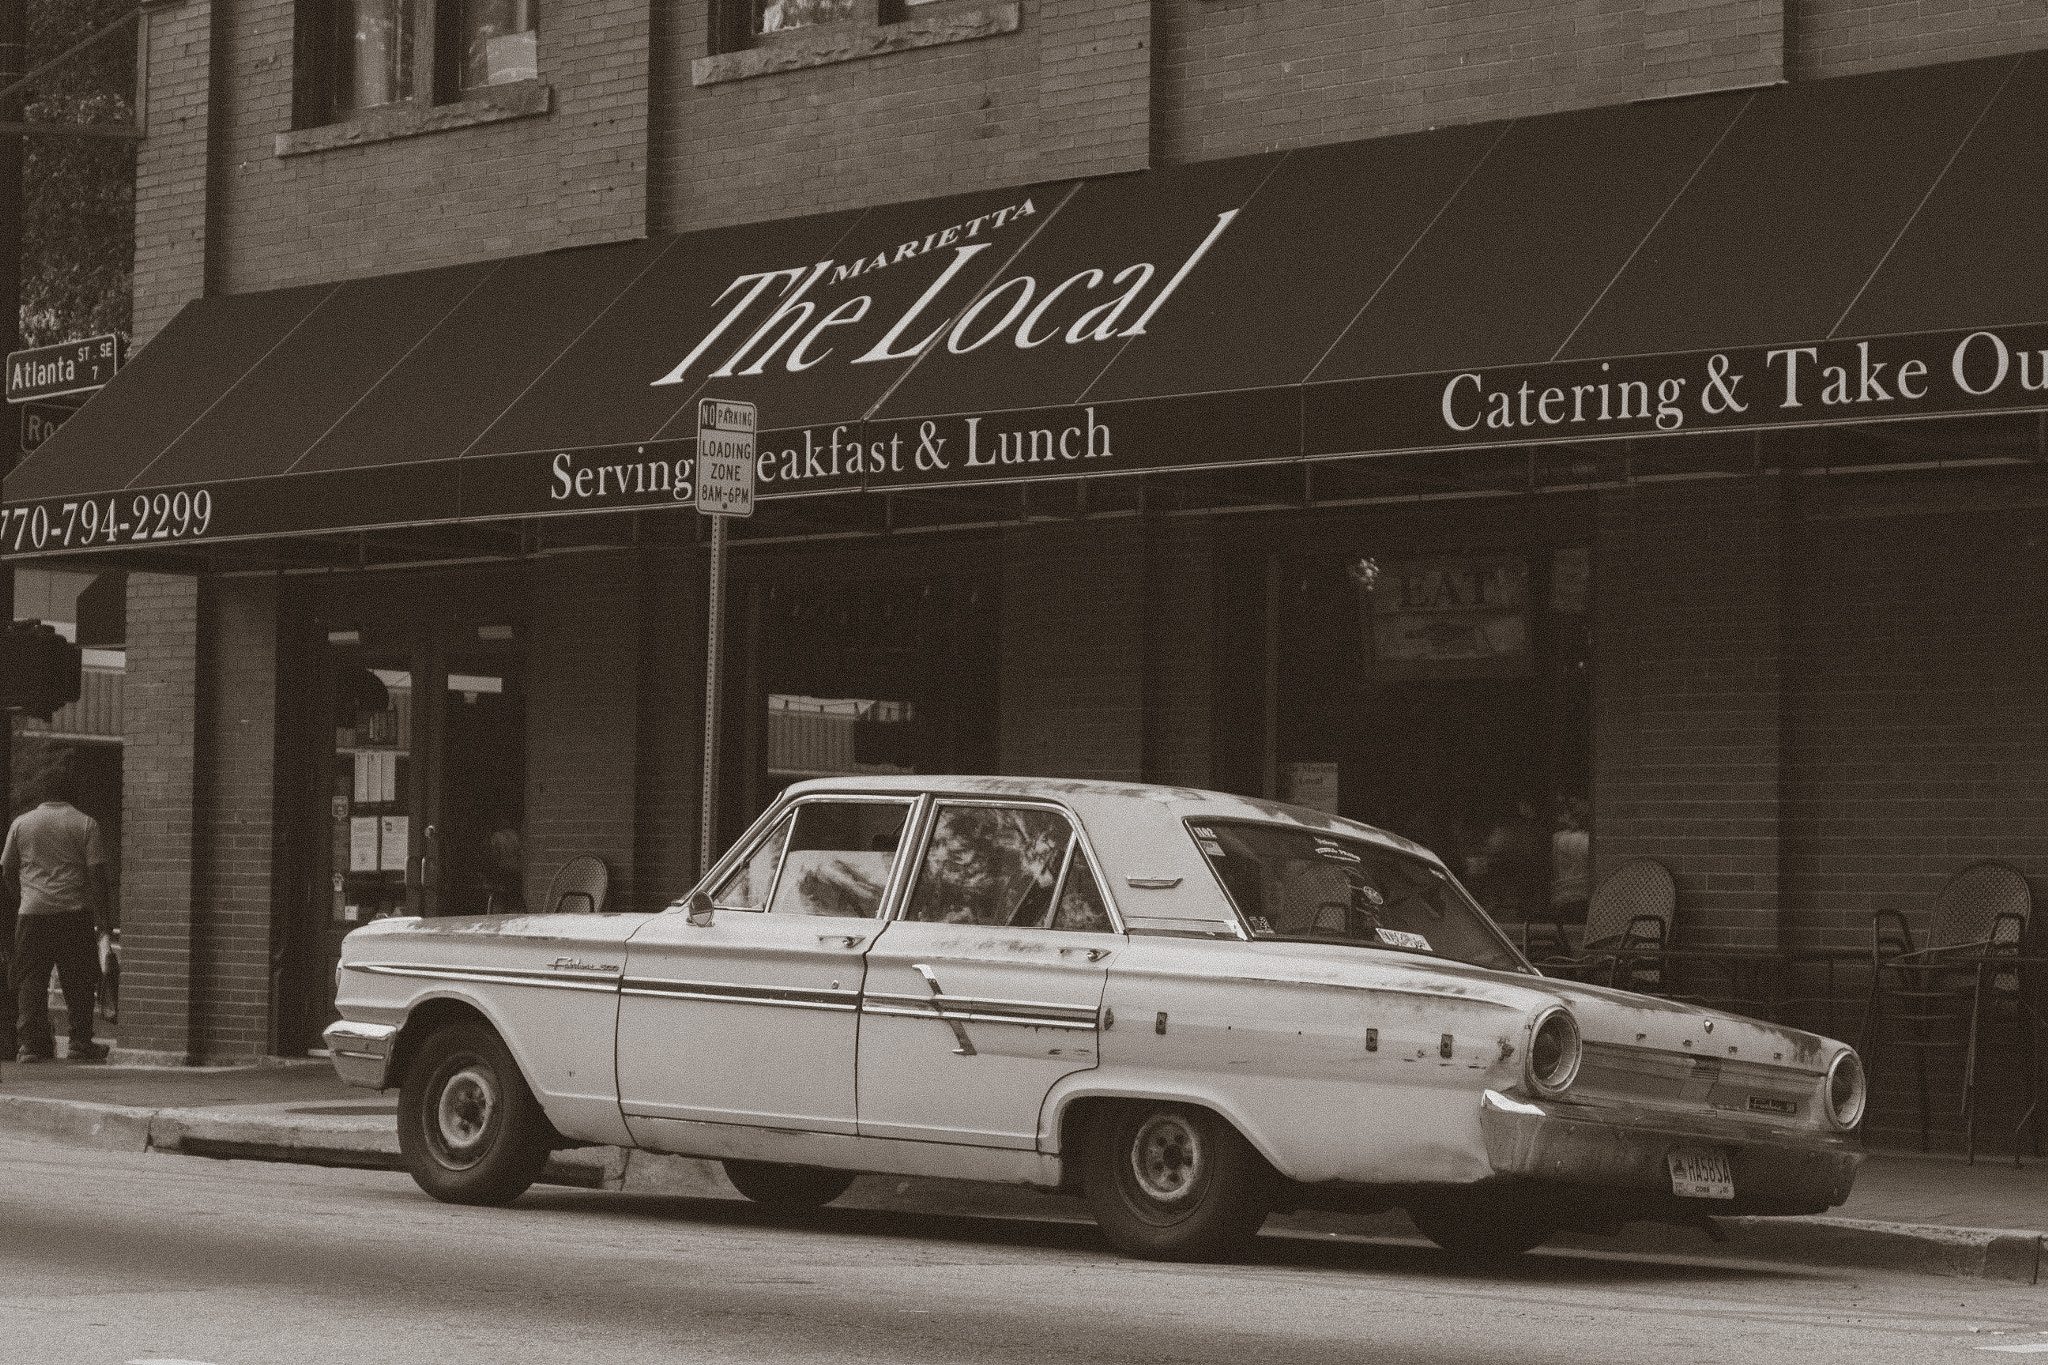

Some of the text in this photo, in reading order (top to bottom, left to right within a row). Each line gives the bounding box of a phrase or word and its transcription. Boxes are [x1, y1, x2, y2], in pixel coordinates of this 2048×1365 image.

[829, 198, 1036, 285] MARIETTA
[649, 207, 1241, 387] The Local
[11, 356, 75, 391] Atlanta
[99, 342, 113, 358] SE
[91, 365, 99, 380] 7
[1441, 362, 1687, 433] Catering
[1700, 353, 1749, 415] &
[1766, 341, 1928, 408] Take
[28, 415, 62, 441] Ro
[701, 404, 752, 427] NO PARKING
[550, 406, 1113, 501] Serving eakfast & Lunch
[702, 440, 751, 460] LOADING
[710, 463, 741, 482] ZONE
[701, 484, 749, 504] 8AM-6PM
